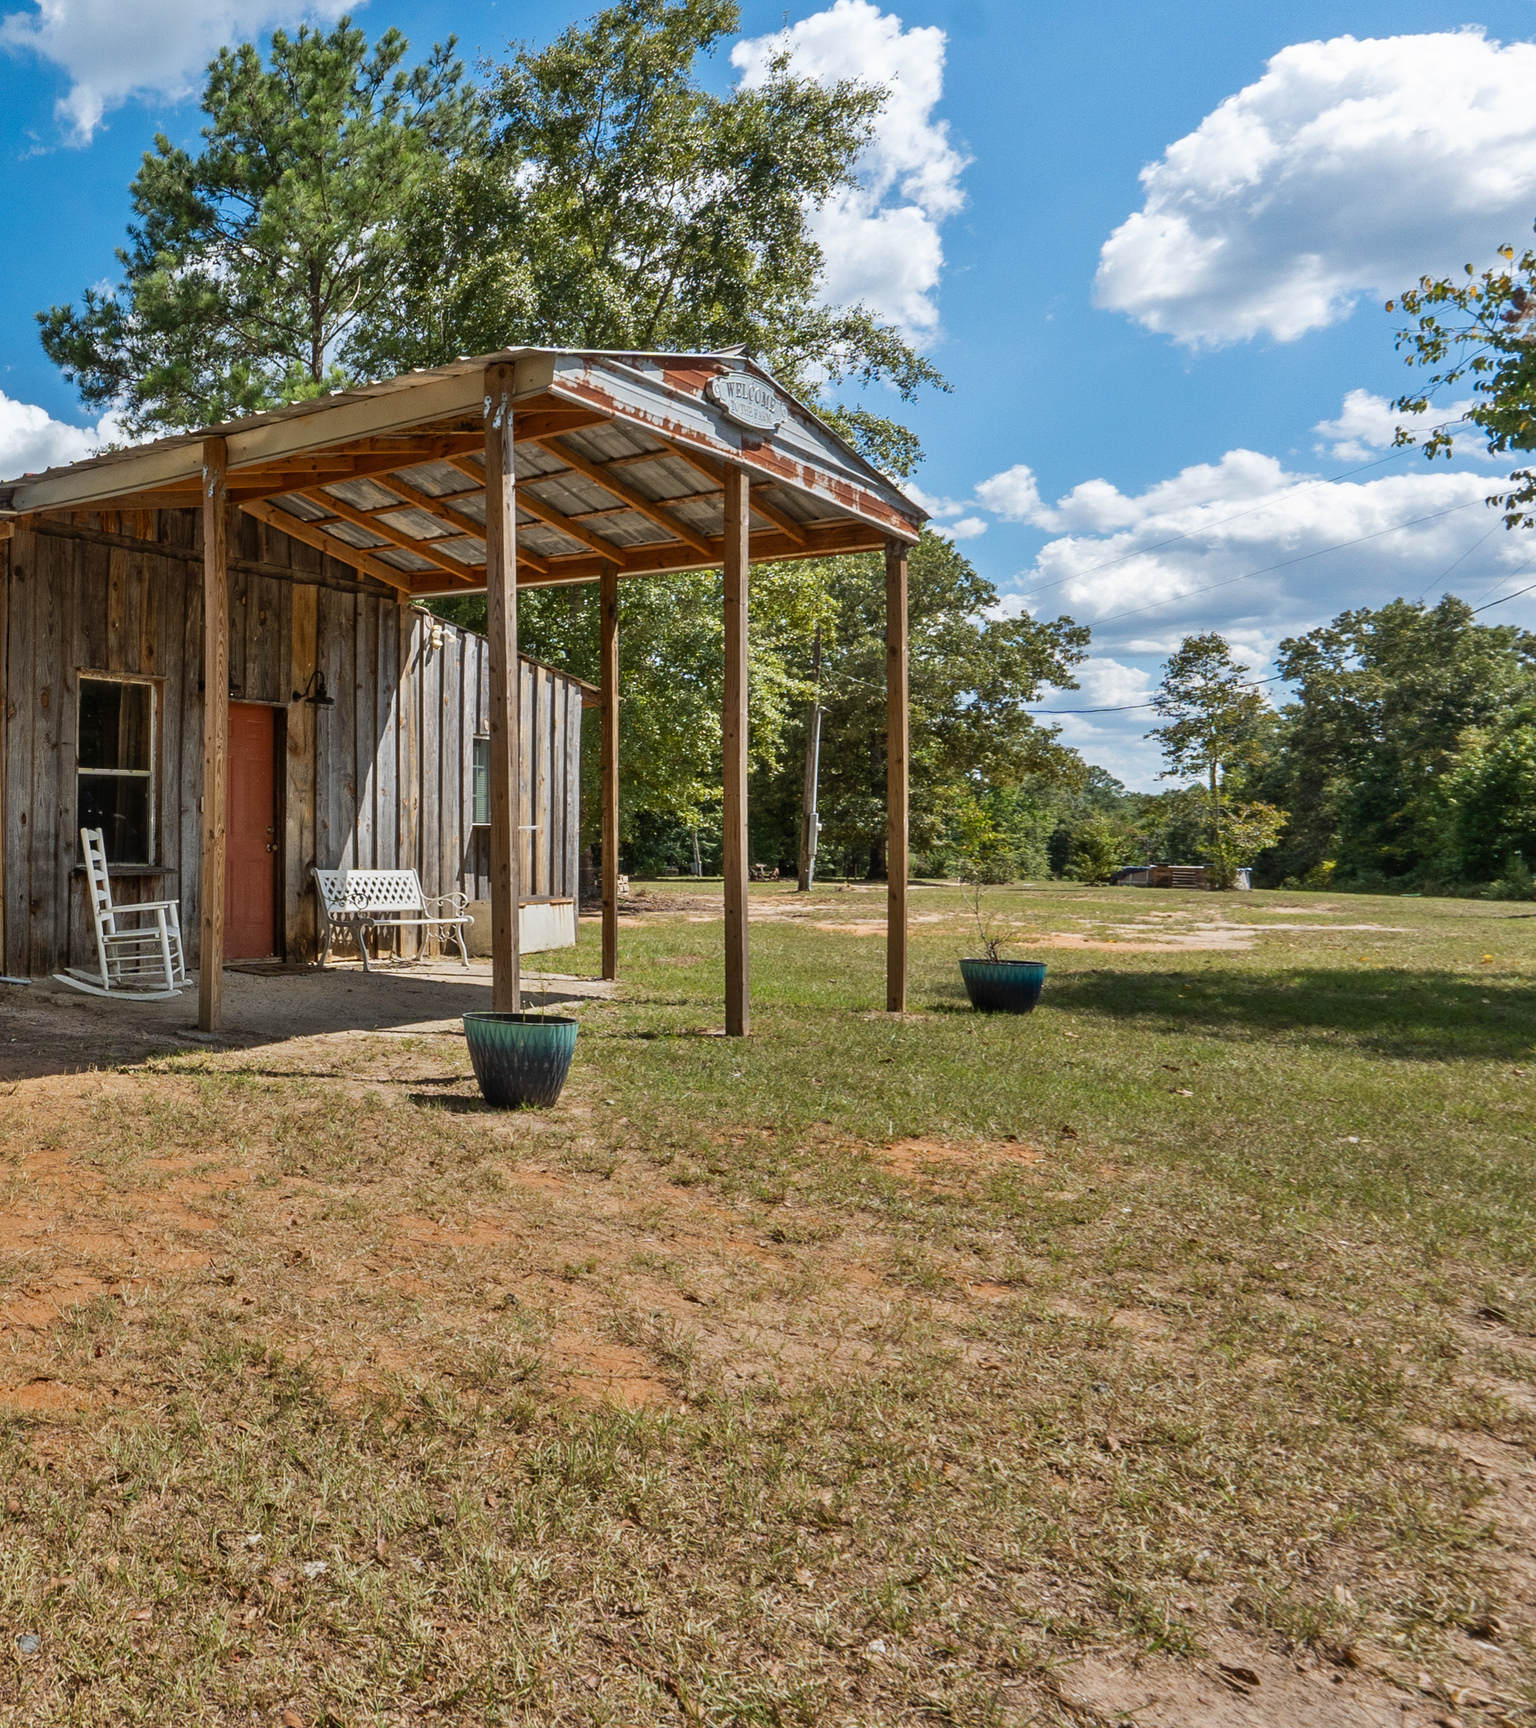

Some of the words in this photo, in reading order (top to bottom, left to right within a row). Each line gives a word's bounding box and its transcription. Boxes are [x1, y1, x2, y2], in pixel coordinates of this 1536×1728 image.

[727, 382, 775, 413] WELCOME
[731, 400, 740, 412] TO
[740, 404, 753, 418] THE
[754, 408, 772, 424] FARM
